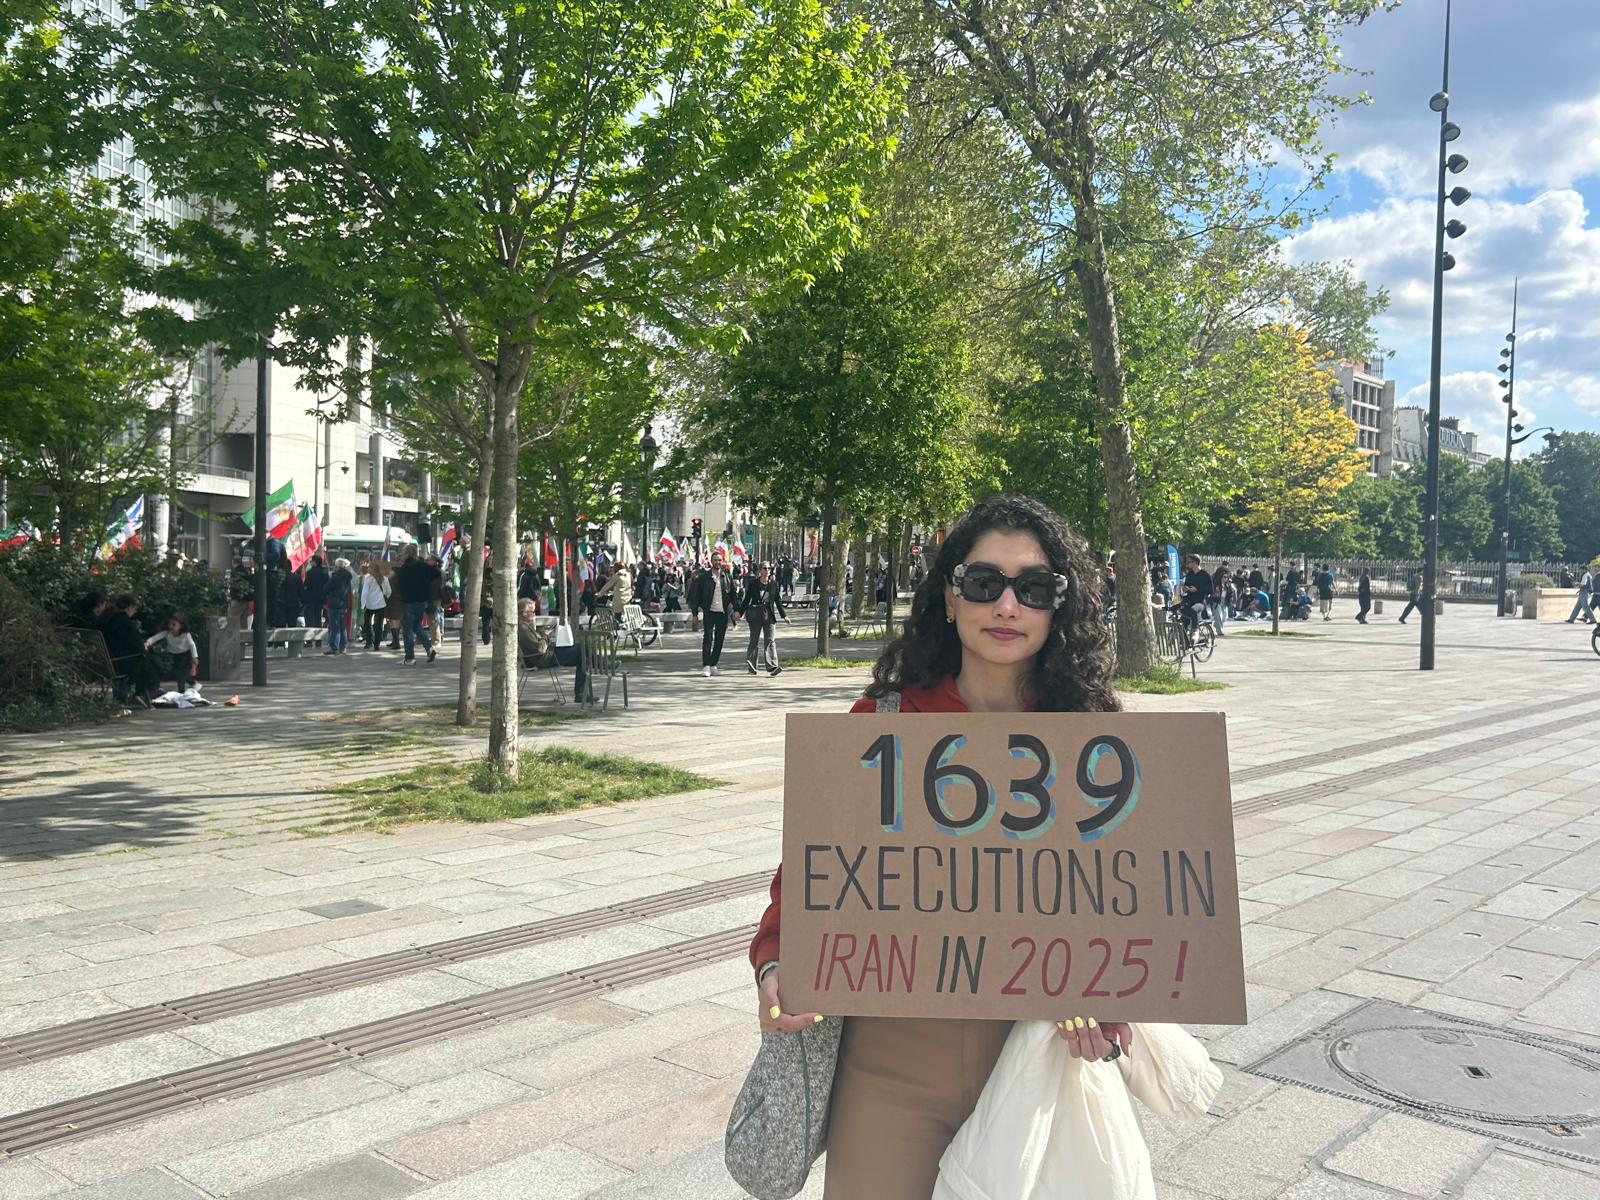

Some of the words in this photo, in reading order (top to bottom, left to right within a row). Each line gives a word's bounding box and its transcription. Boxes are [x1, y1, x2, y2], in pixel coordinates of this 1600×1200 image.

[861, 734, 1143, 842] 1639
[805, 844, 1138, 916] EXECUTIONS
[1163, 850, 1216, 917] IN
[814, 933, 919, 994] IRAN
[936, 935, 987, 994] IN
